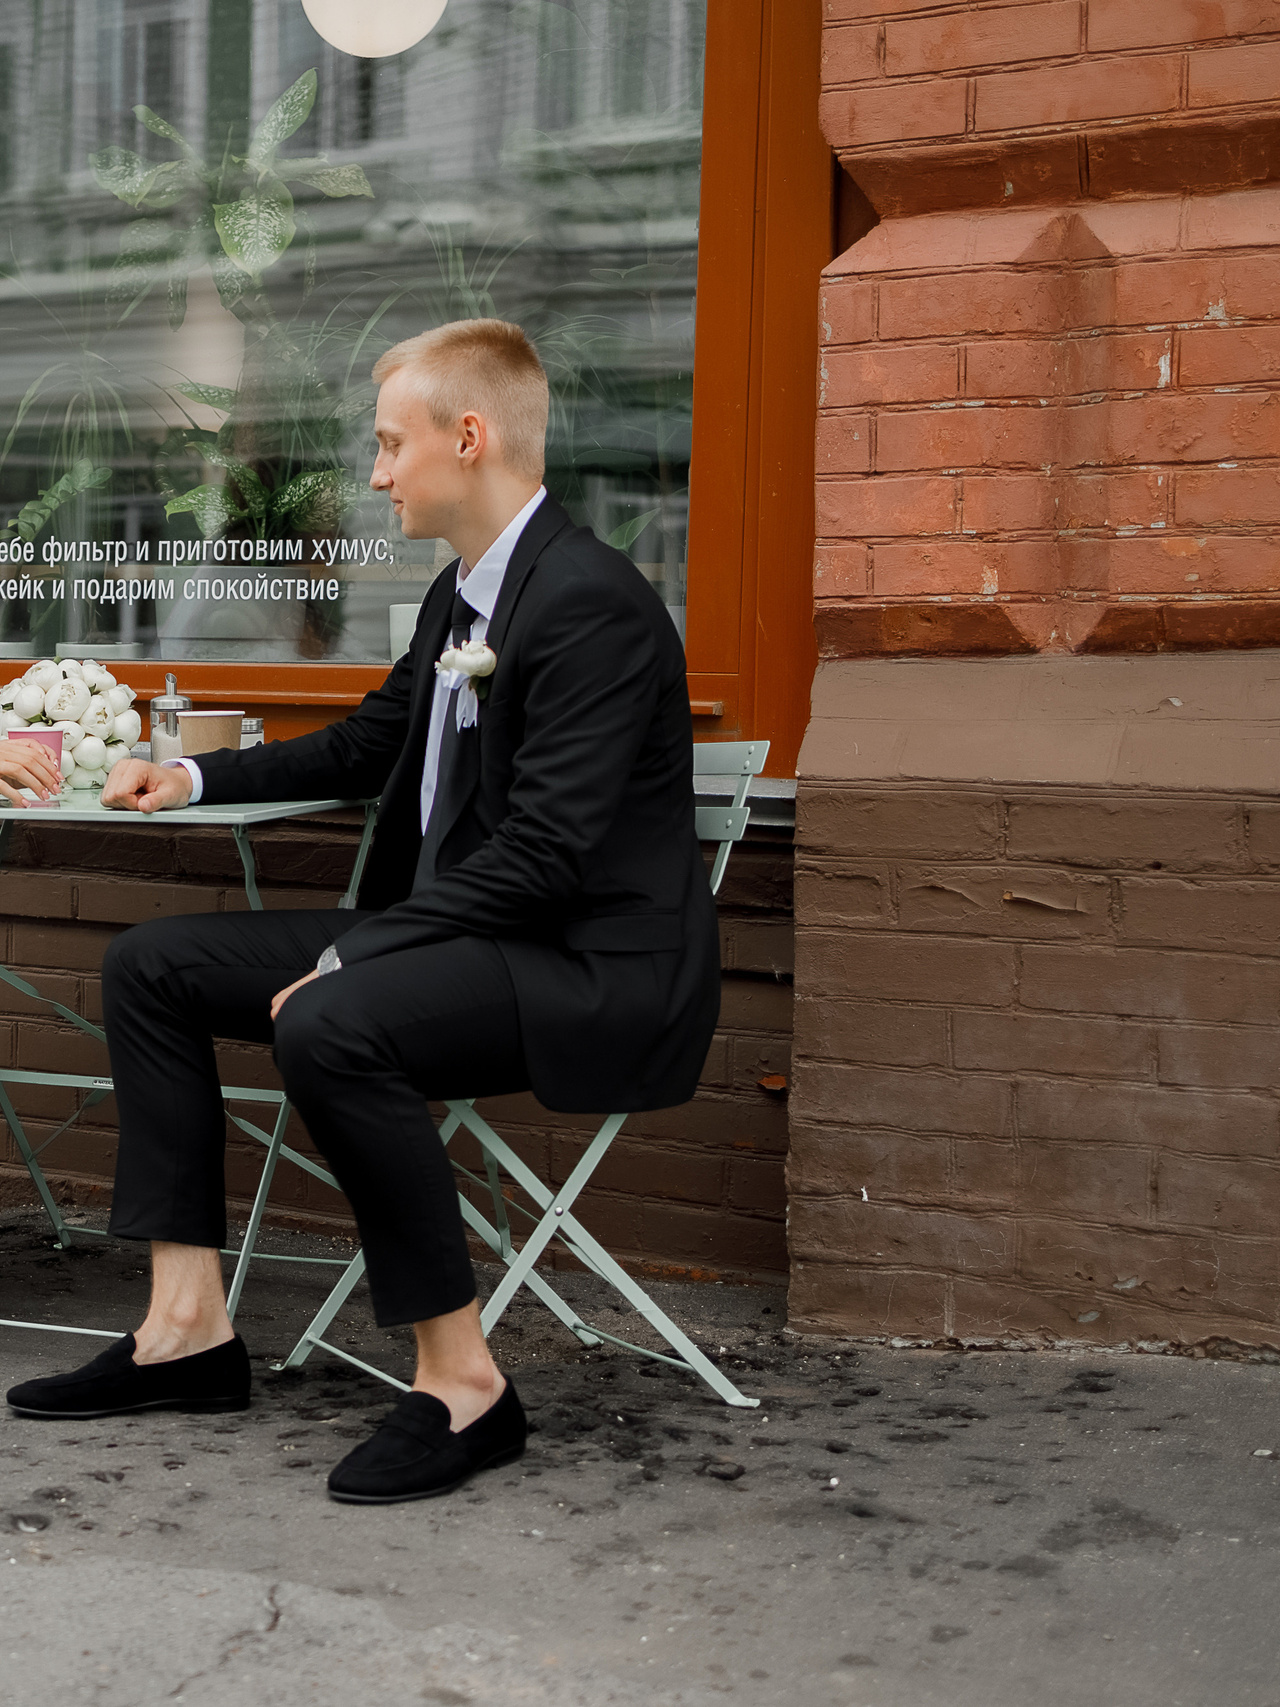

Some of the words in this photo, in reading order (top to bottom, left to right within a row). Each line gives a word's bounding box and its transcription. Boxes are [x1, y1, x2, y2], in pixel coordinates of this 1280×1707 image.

[42, 536, 128, 568] фильтр
[136, 540, 150, 561] и
[157, 538, 303, 567] приготовим
[311, 538, 395, 567] хумус,
[52, 579, 65, 600] и
[73, 578, 175, 605] подарим
[183, 573, 340, 601] спокойствие
